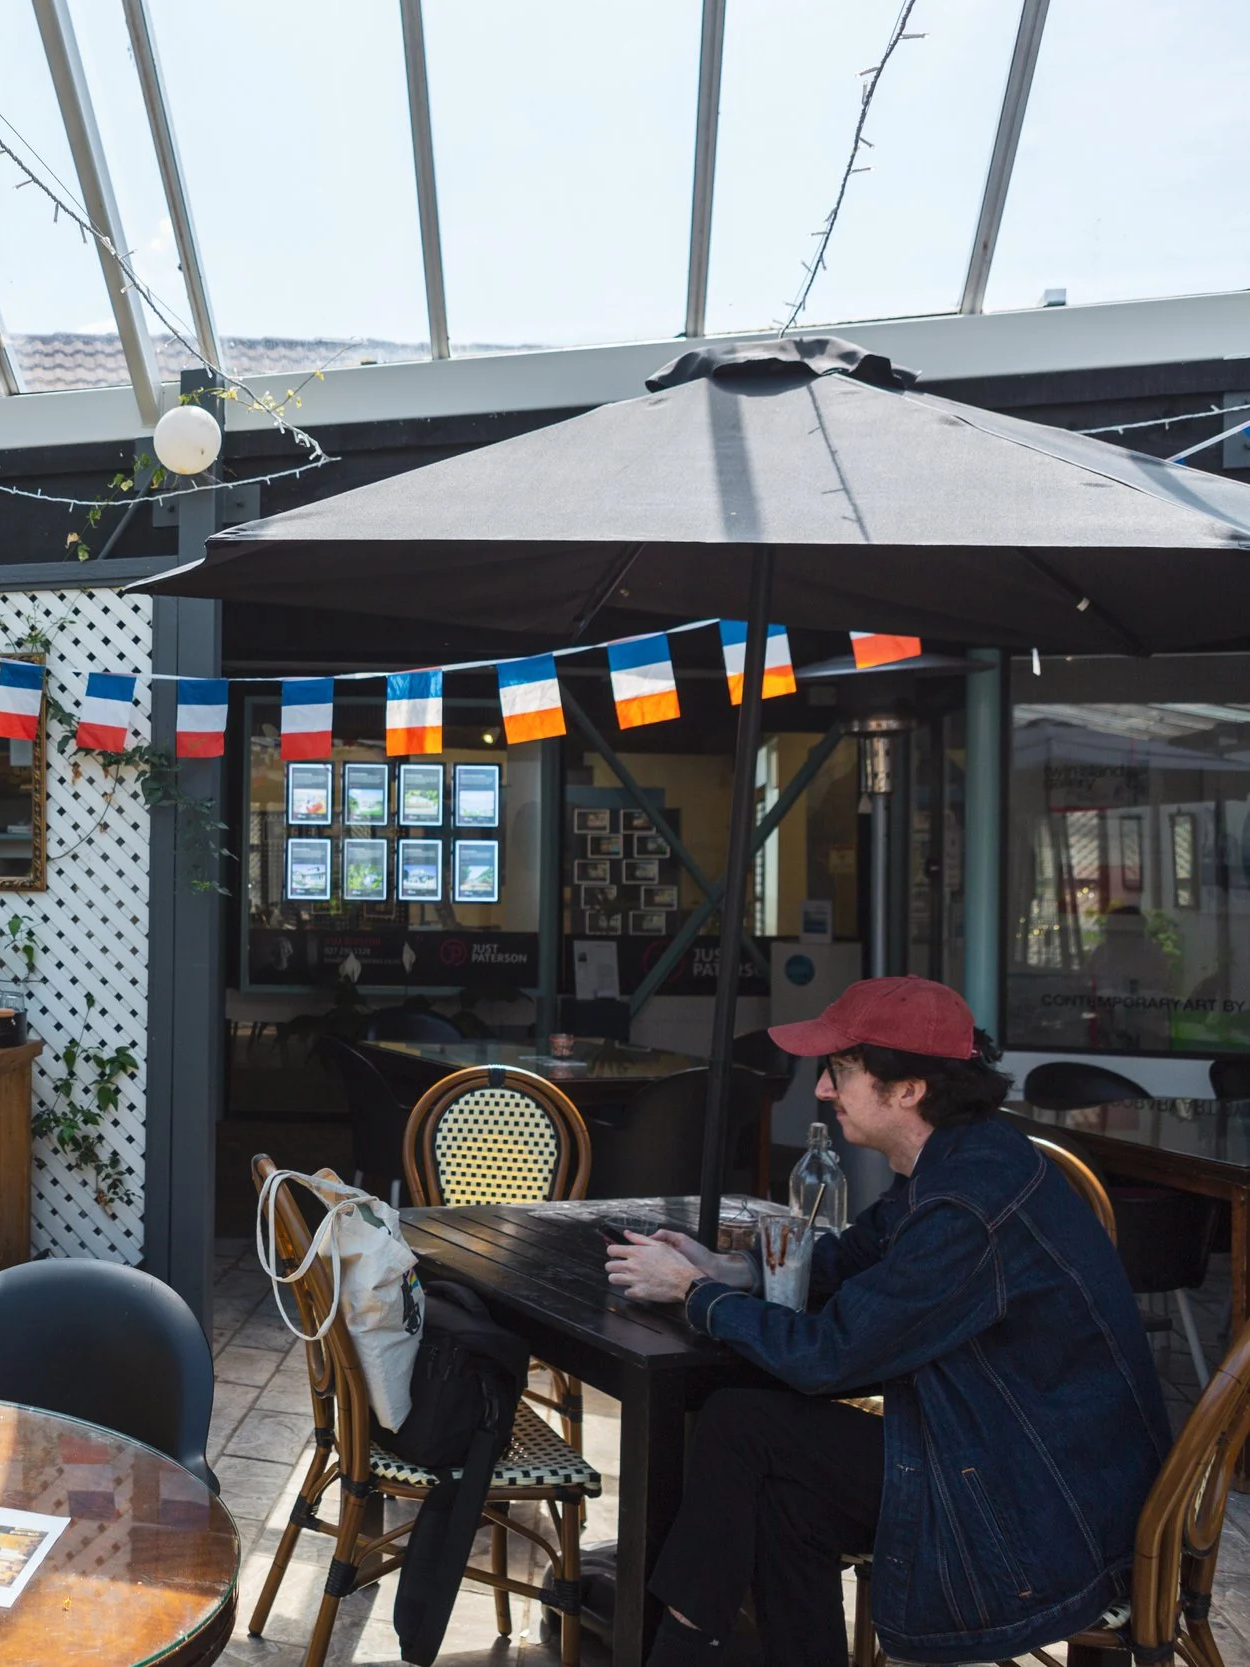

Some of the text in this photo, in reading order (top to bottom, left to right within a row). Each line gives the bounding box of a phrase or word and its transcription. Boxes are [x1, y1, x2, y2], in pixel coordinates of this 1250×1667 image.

[471, 943, 499, 954] JUST
[471, 953, 528, 964] PATERSON
[693, 948, 722, 962] JUS
[1040, 994, 1246, 1013] CONTEMPORARY ART BY
